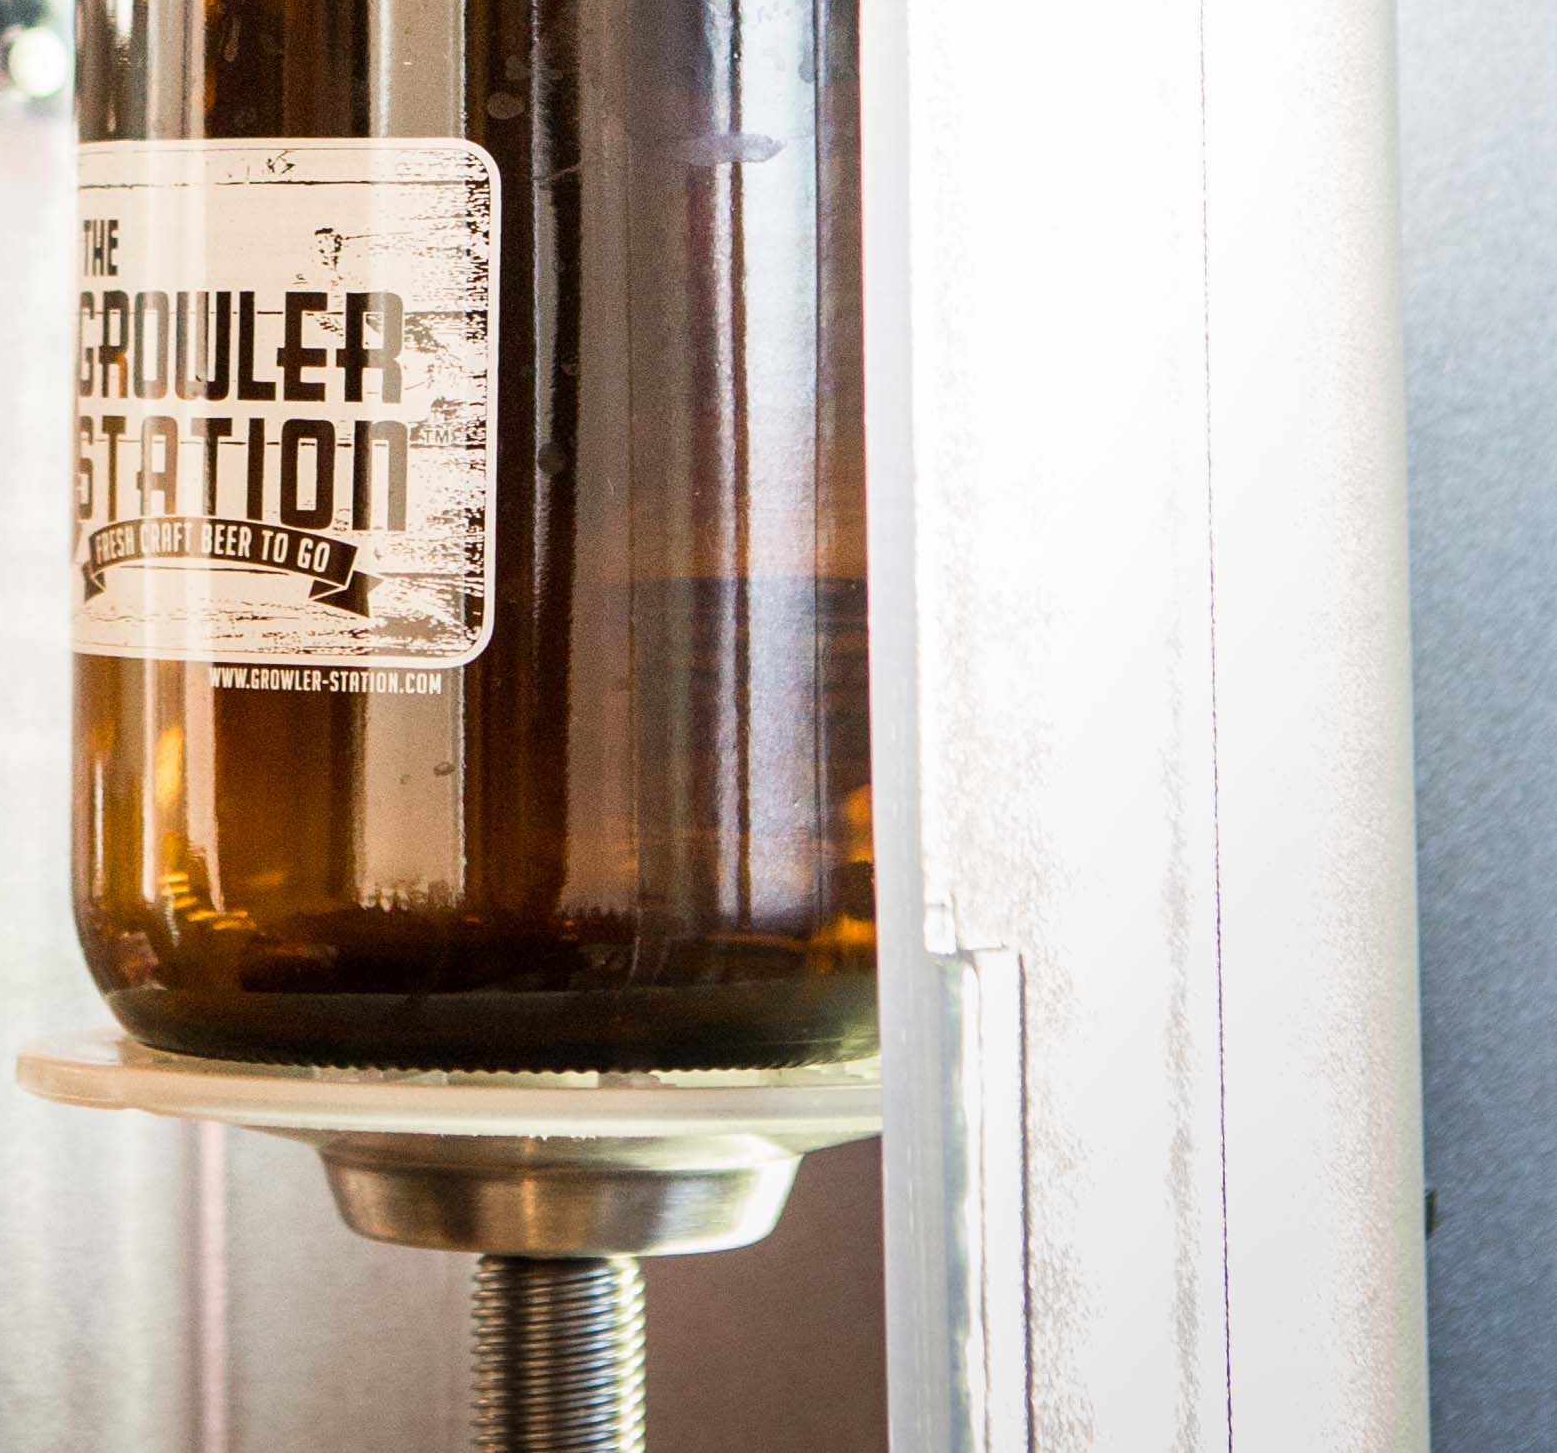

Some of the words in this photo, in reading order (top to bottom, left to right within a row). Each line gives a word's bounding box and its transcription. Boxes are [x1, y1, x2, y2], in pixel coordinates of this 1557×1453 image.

[83, 219, 119, 277] THE
[75, 290, 405, 404] GROWLER
[75, 415, 409, 532] STATION
[96, 524, 136, 566] FRESH
[141, 522, 193, 555] CRAFT
[201, 523, 253, 559] BEER
[261, 530, 290, 564] TO
[296, 537, 332, 574] GO
[209, 666, 443, 695] WWW.GROWLER-STATION.COM
